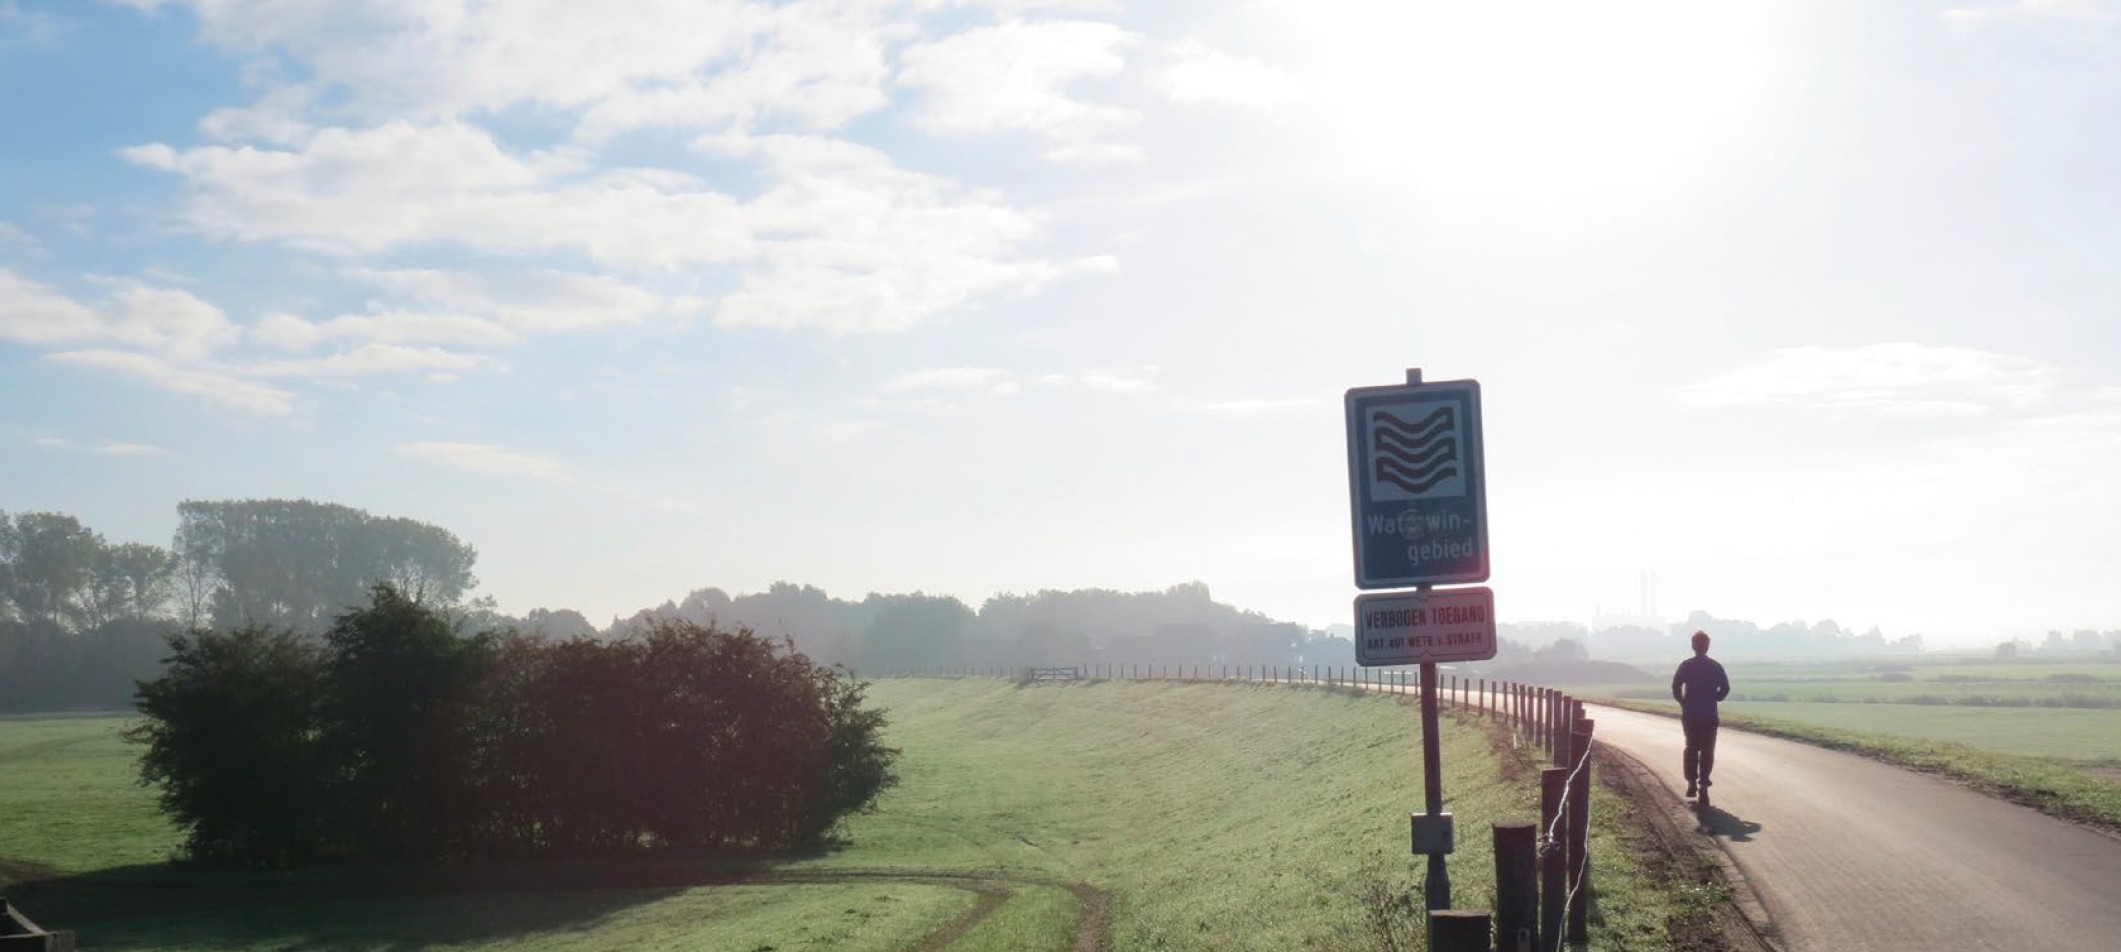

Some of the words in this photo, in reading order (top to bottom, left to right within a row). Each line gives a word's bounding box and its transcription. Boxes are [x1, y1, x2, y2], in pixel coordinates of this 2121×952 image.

[1367, 509, 1471, 535] Watwin-
[1407, 537, 1472, 565] gebied
[1366, 608, 1427, 629] VERBODEN
[1431, 605, 1485, 625] TOEGANG
